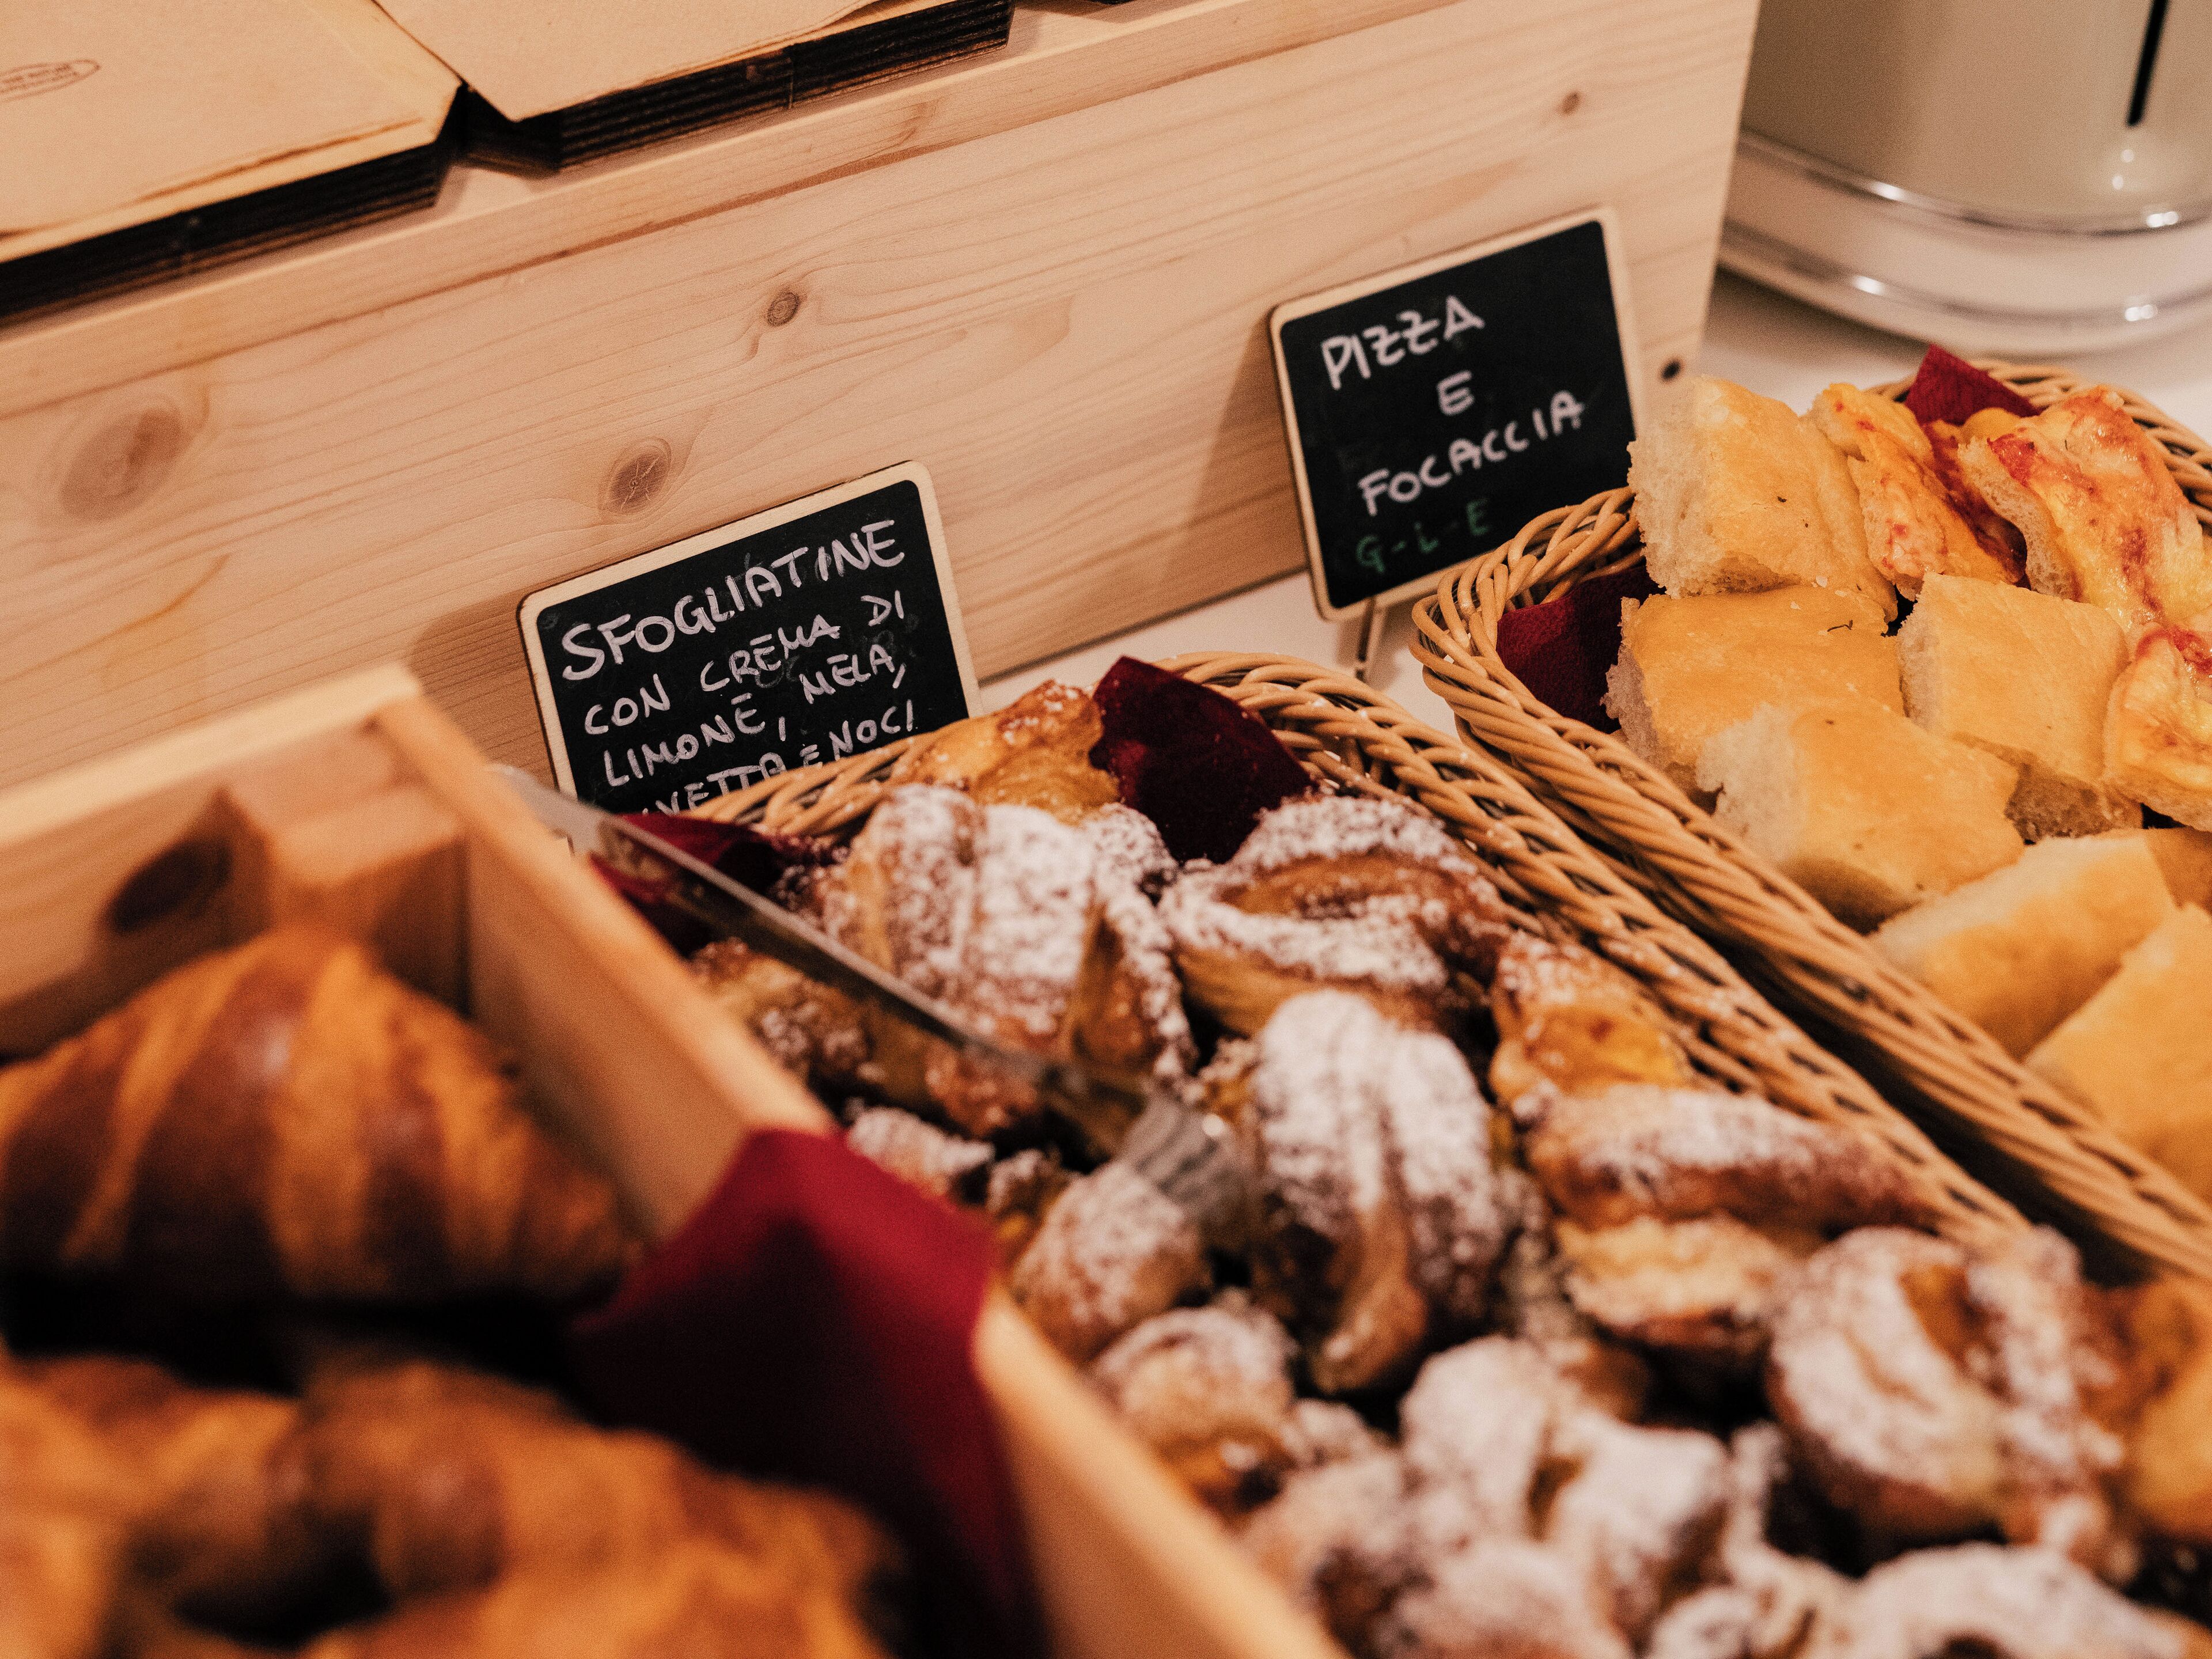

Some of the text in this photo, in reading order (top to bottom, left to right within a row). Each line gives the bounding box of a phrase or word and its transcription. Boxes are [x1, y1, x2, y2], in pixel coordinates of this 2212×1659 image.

[1321, 295, 1485, 390] PIZZA
[1437, 370, 1475, 416] E
[1358, 390, 1585, 516] FOCACCIA
[562, 520, 904, 680] SFOGLIATINE
[585, 590, 904, 735] CON CREMA DI
[799, 645, 906, 704] MELA,
[642, 752, 787, 816] VETTA
[829, 699, 914, 760] NOCI
